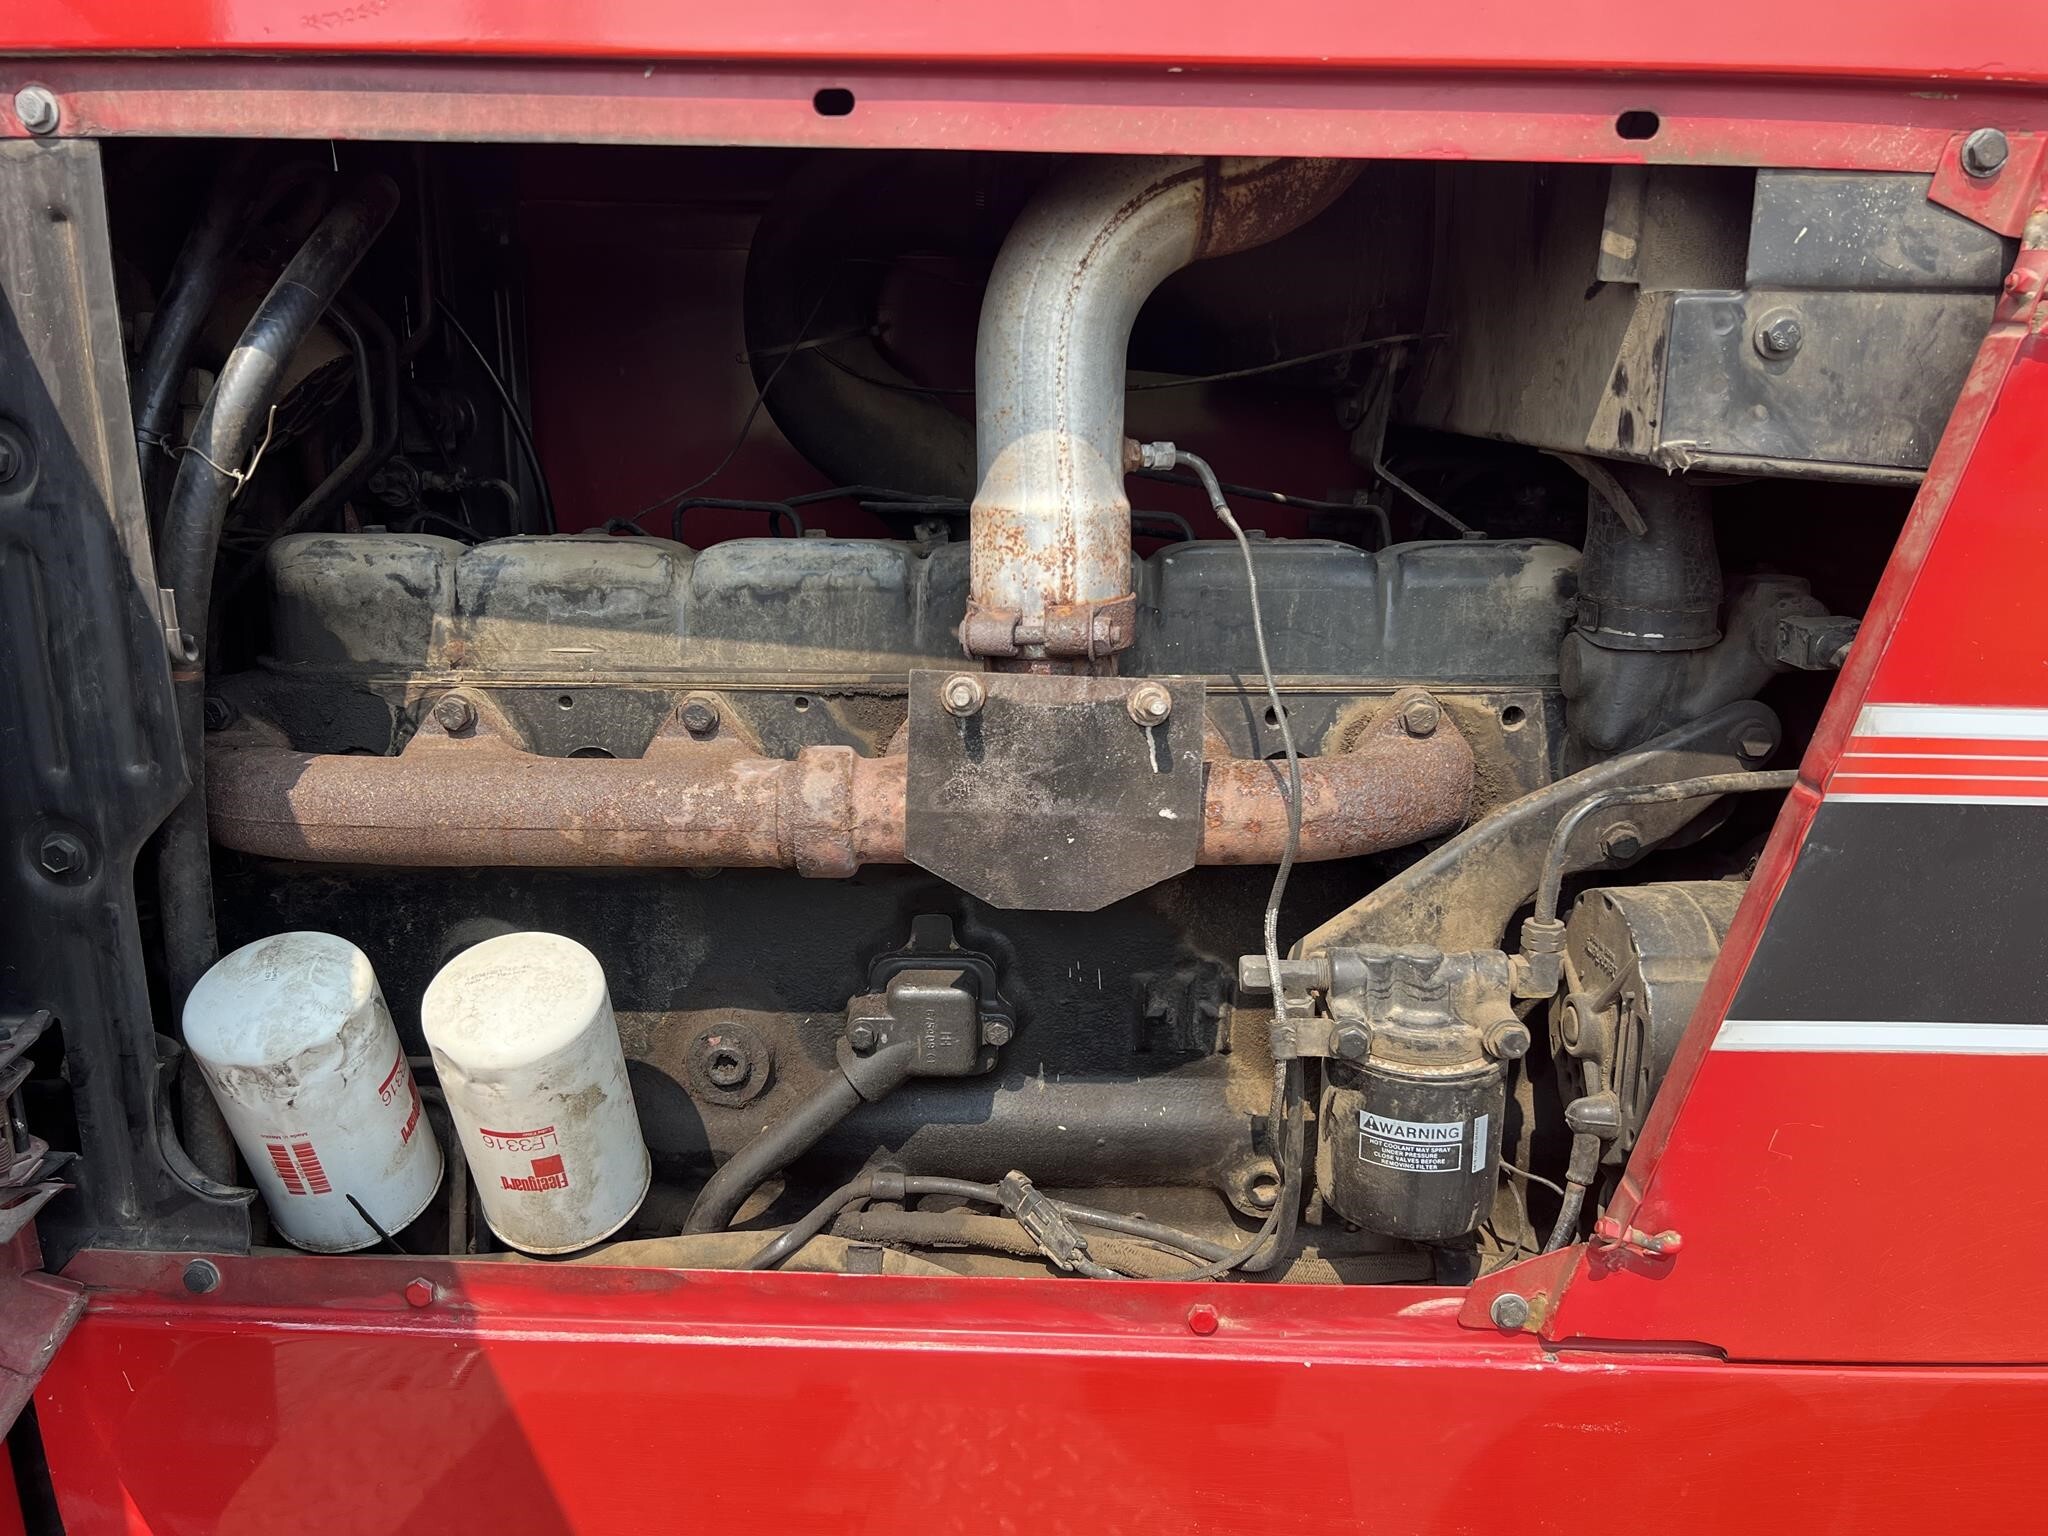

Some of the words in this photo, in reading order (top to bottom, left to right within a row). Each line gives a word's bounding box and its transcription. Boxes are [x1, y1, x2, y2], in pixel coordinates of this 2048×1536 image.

[290, 1131, 309, 1139] Made
[1380, 1122, 1460, 1140] WARNING
[482, 1133, 558, 1152] LF3316
[1369, 1138, 1382, 1147] HOT
[1383, 1141, 1414, 1153] COOLANT
[1374, 1151, 1394, 1160] CLOSE
[1395, 1155, 1420, 1164] VALVES
[1382, 1147, 1404, 1157] UNDER
[1381, 1158, 1415, 1169] REMOVING
[500, 1172, 569, 1192] Fleetguard
